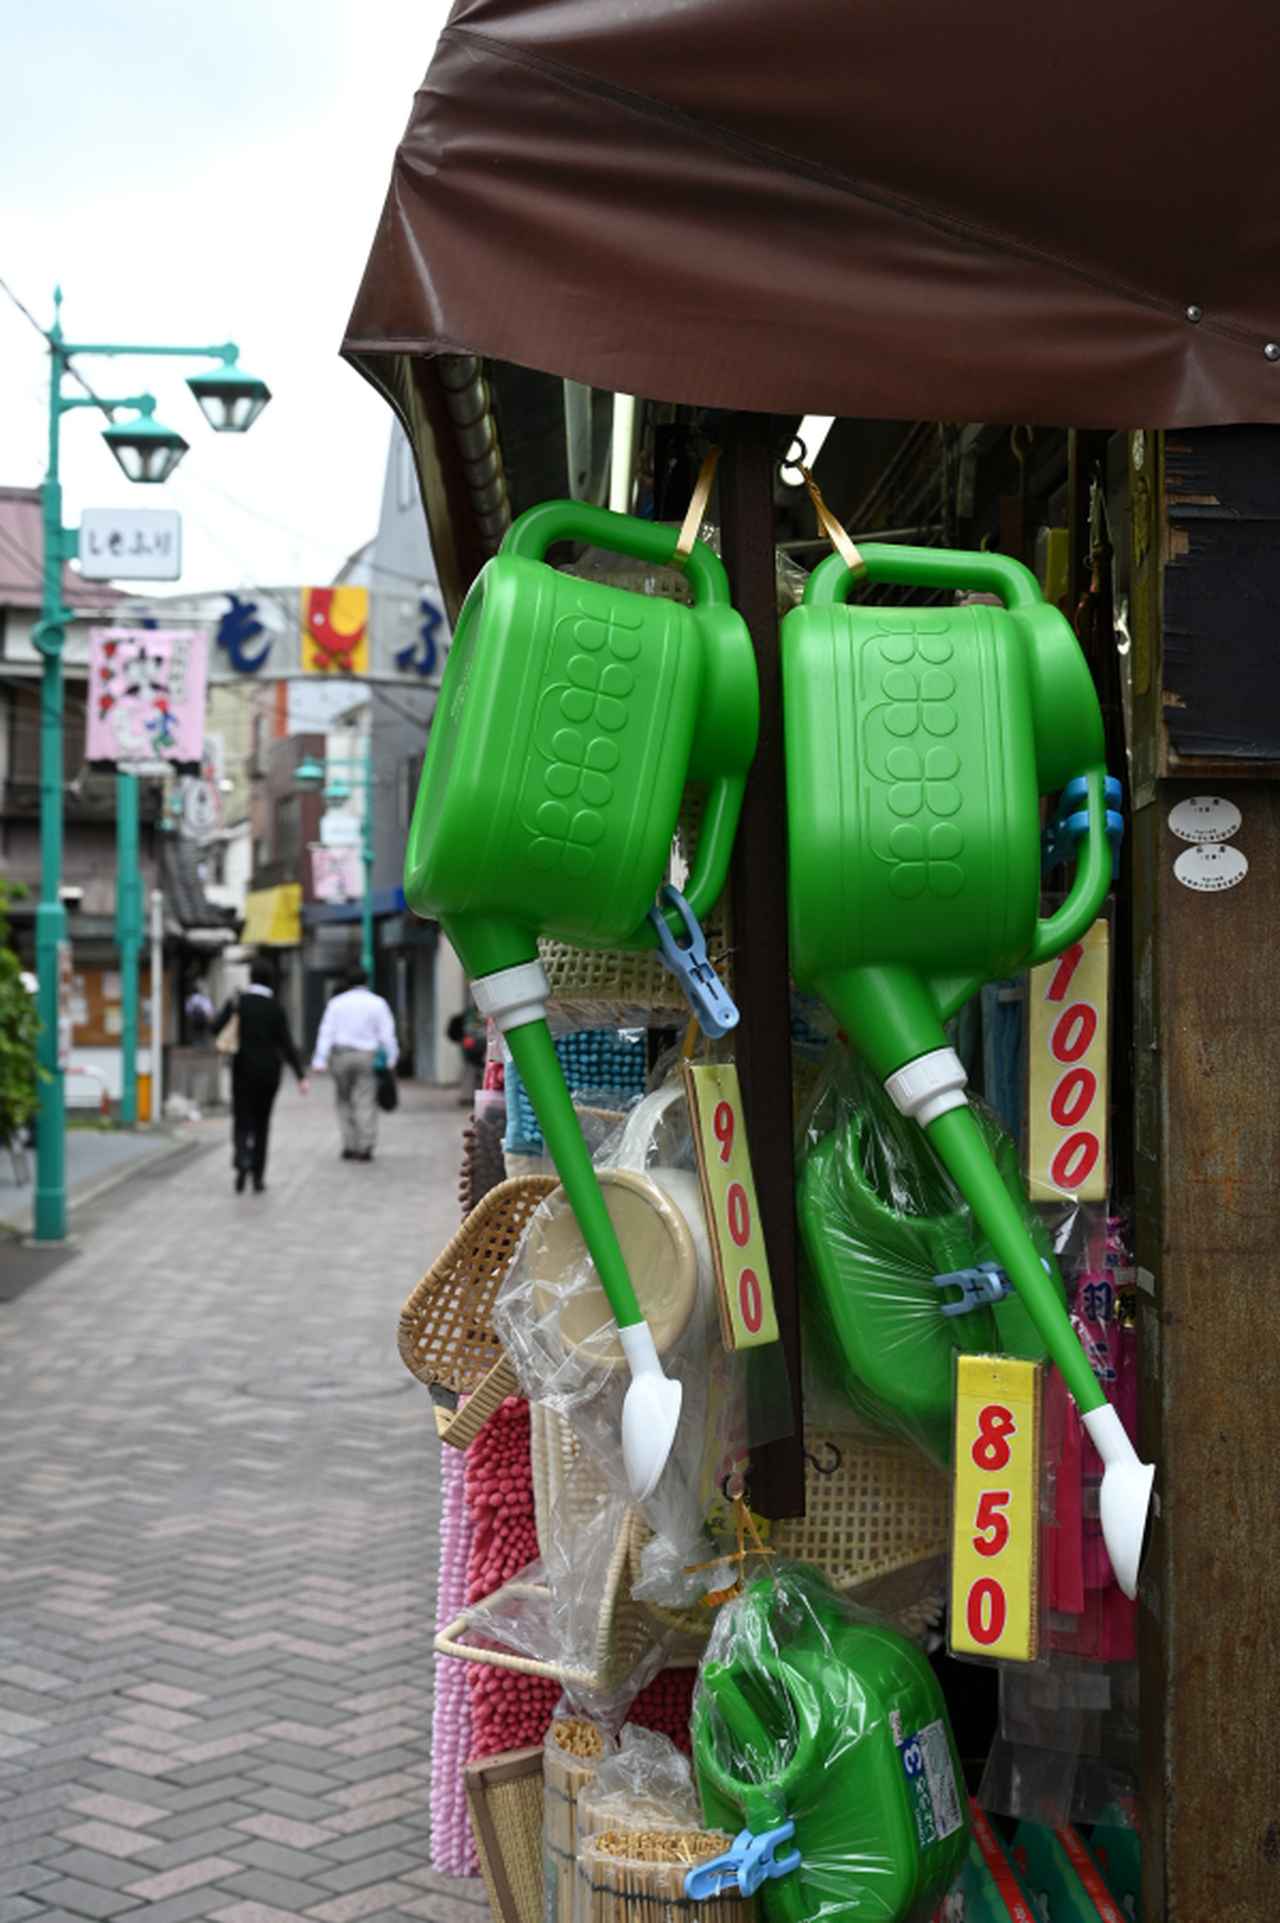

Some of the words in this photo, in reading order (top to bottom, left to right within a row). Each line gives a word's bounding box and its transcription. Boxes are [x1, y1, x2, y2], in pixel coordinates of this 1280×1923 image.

[1045, 943, 1101, 1190] 1000
[713, 1100, 762, 1334] 900
[966, 1404, 1016, 1646] 850
